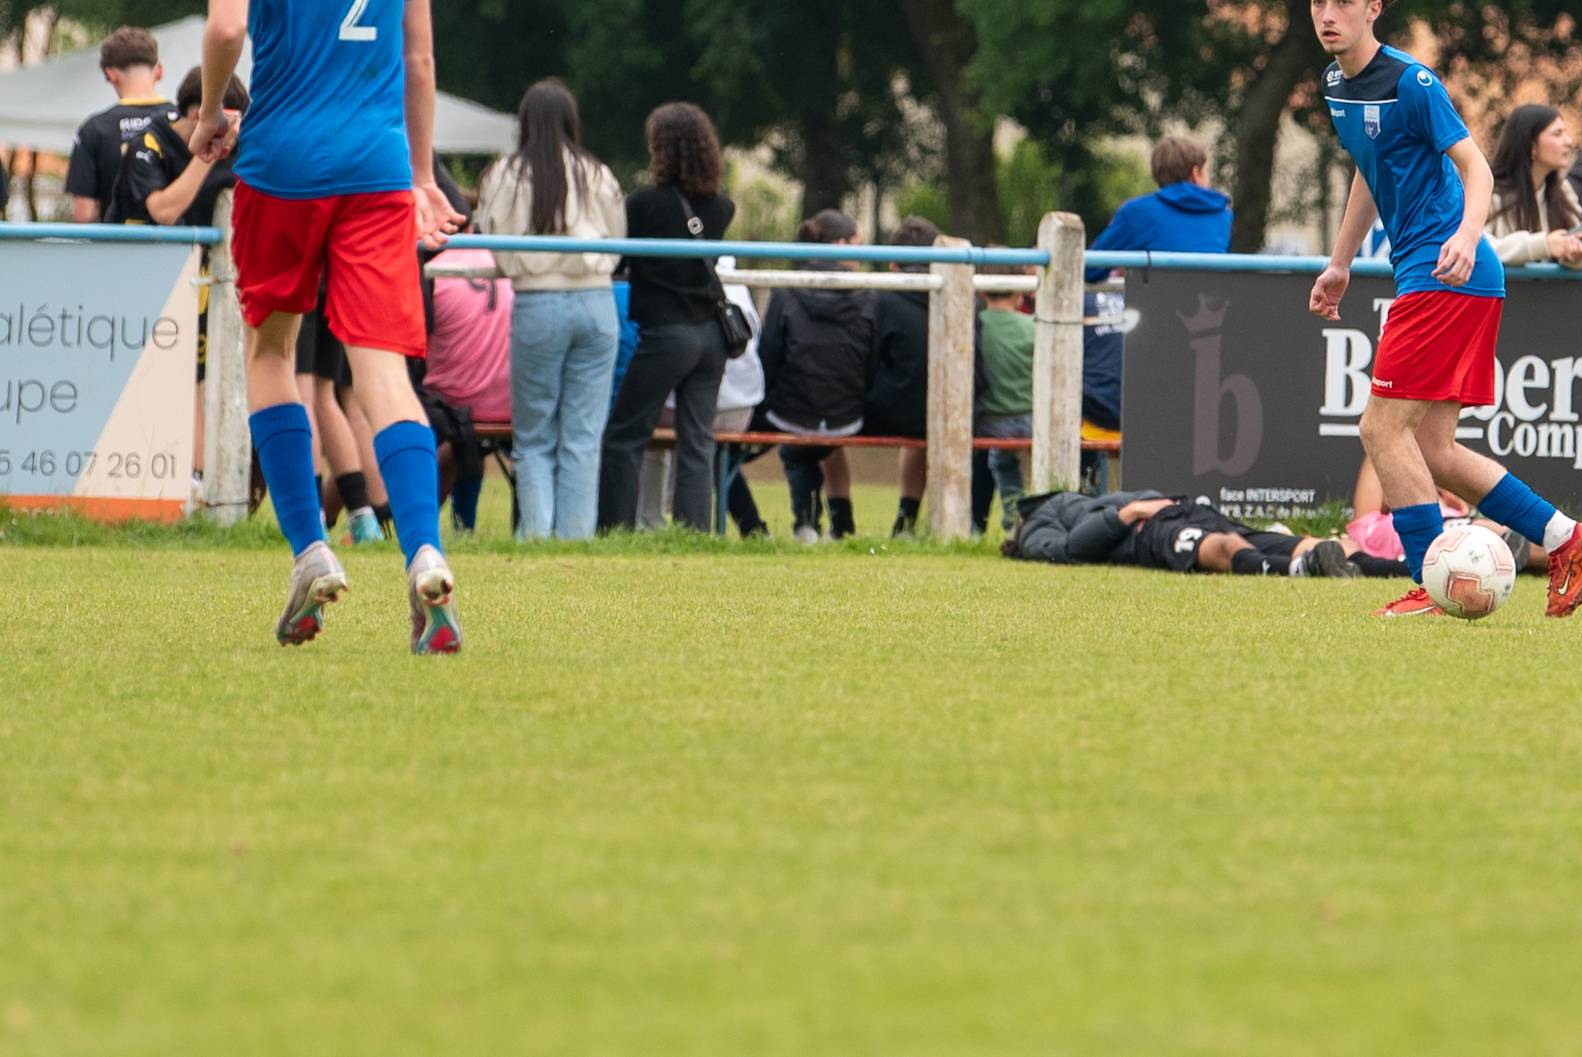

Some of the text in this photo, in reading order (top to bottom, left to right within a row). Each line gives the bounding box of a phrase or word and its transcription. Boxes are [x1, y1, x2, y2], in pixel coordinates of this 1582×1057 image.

[21, 449, 57, 477] 46
[65, 450, 97, 478] 07
[107, 451, 141, 479] 26
[151, 453, 177, 479] 01
[1246, 488, 1316, 503] INTERSPORT
